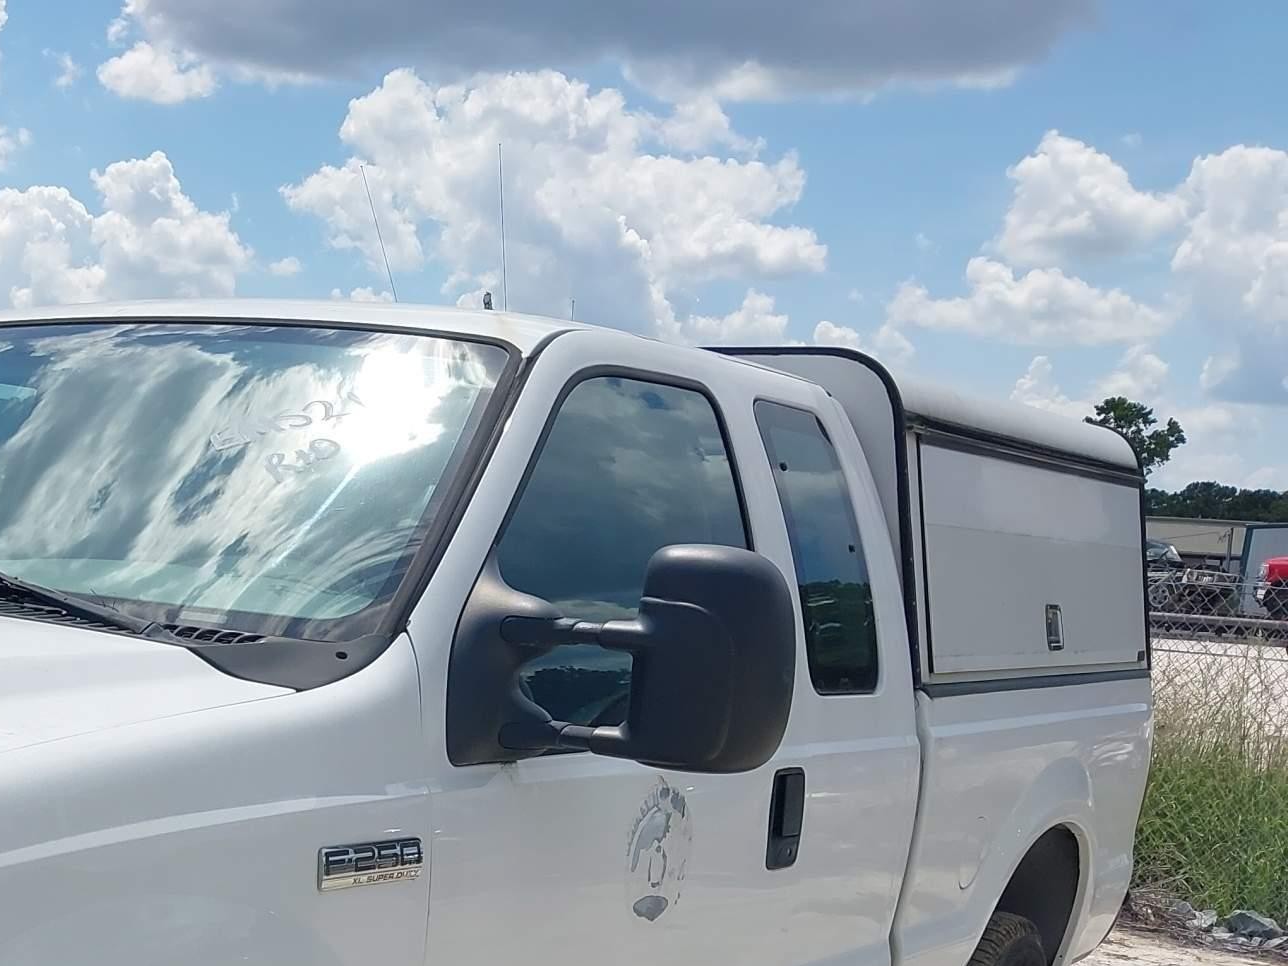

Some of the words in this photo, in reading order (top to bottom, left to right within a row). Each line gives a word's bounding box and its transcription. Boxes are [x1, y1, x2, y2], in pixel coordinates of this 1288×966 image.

[352, 877, 363, 885] XL
[366, 872, 395, 882] SUPER
[395, 869, 420, 879] DUTY
